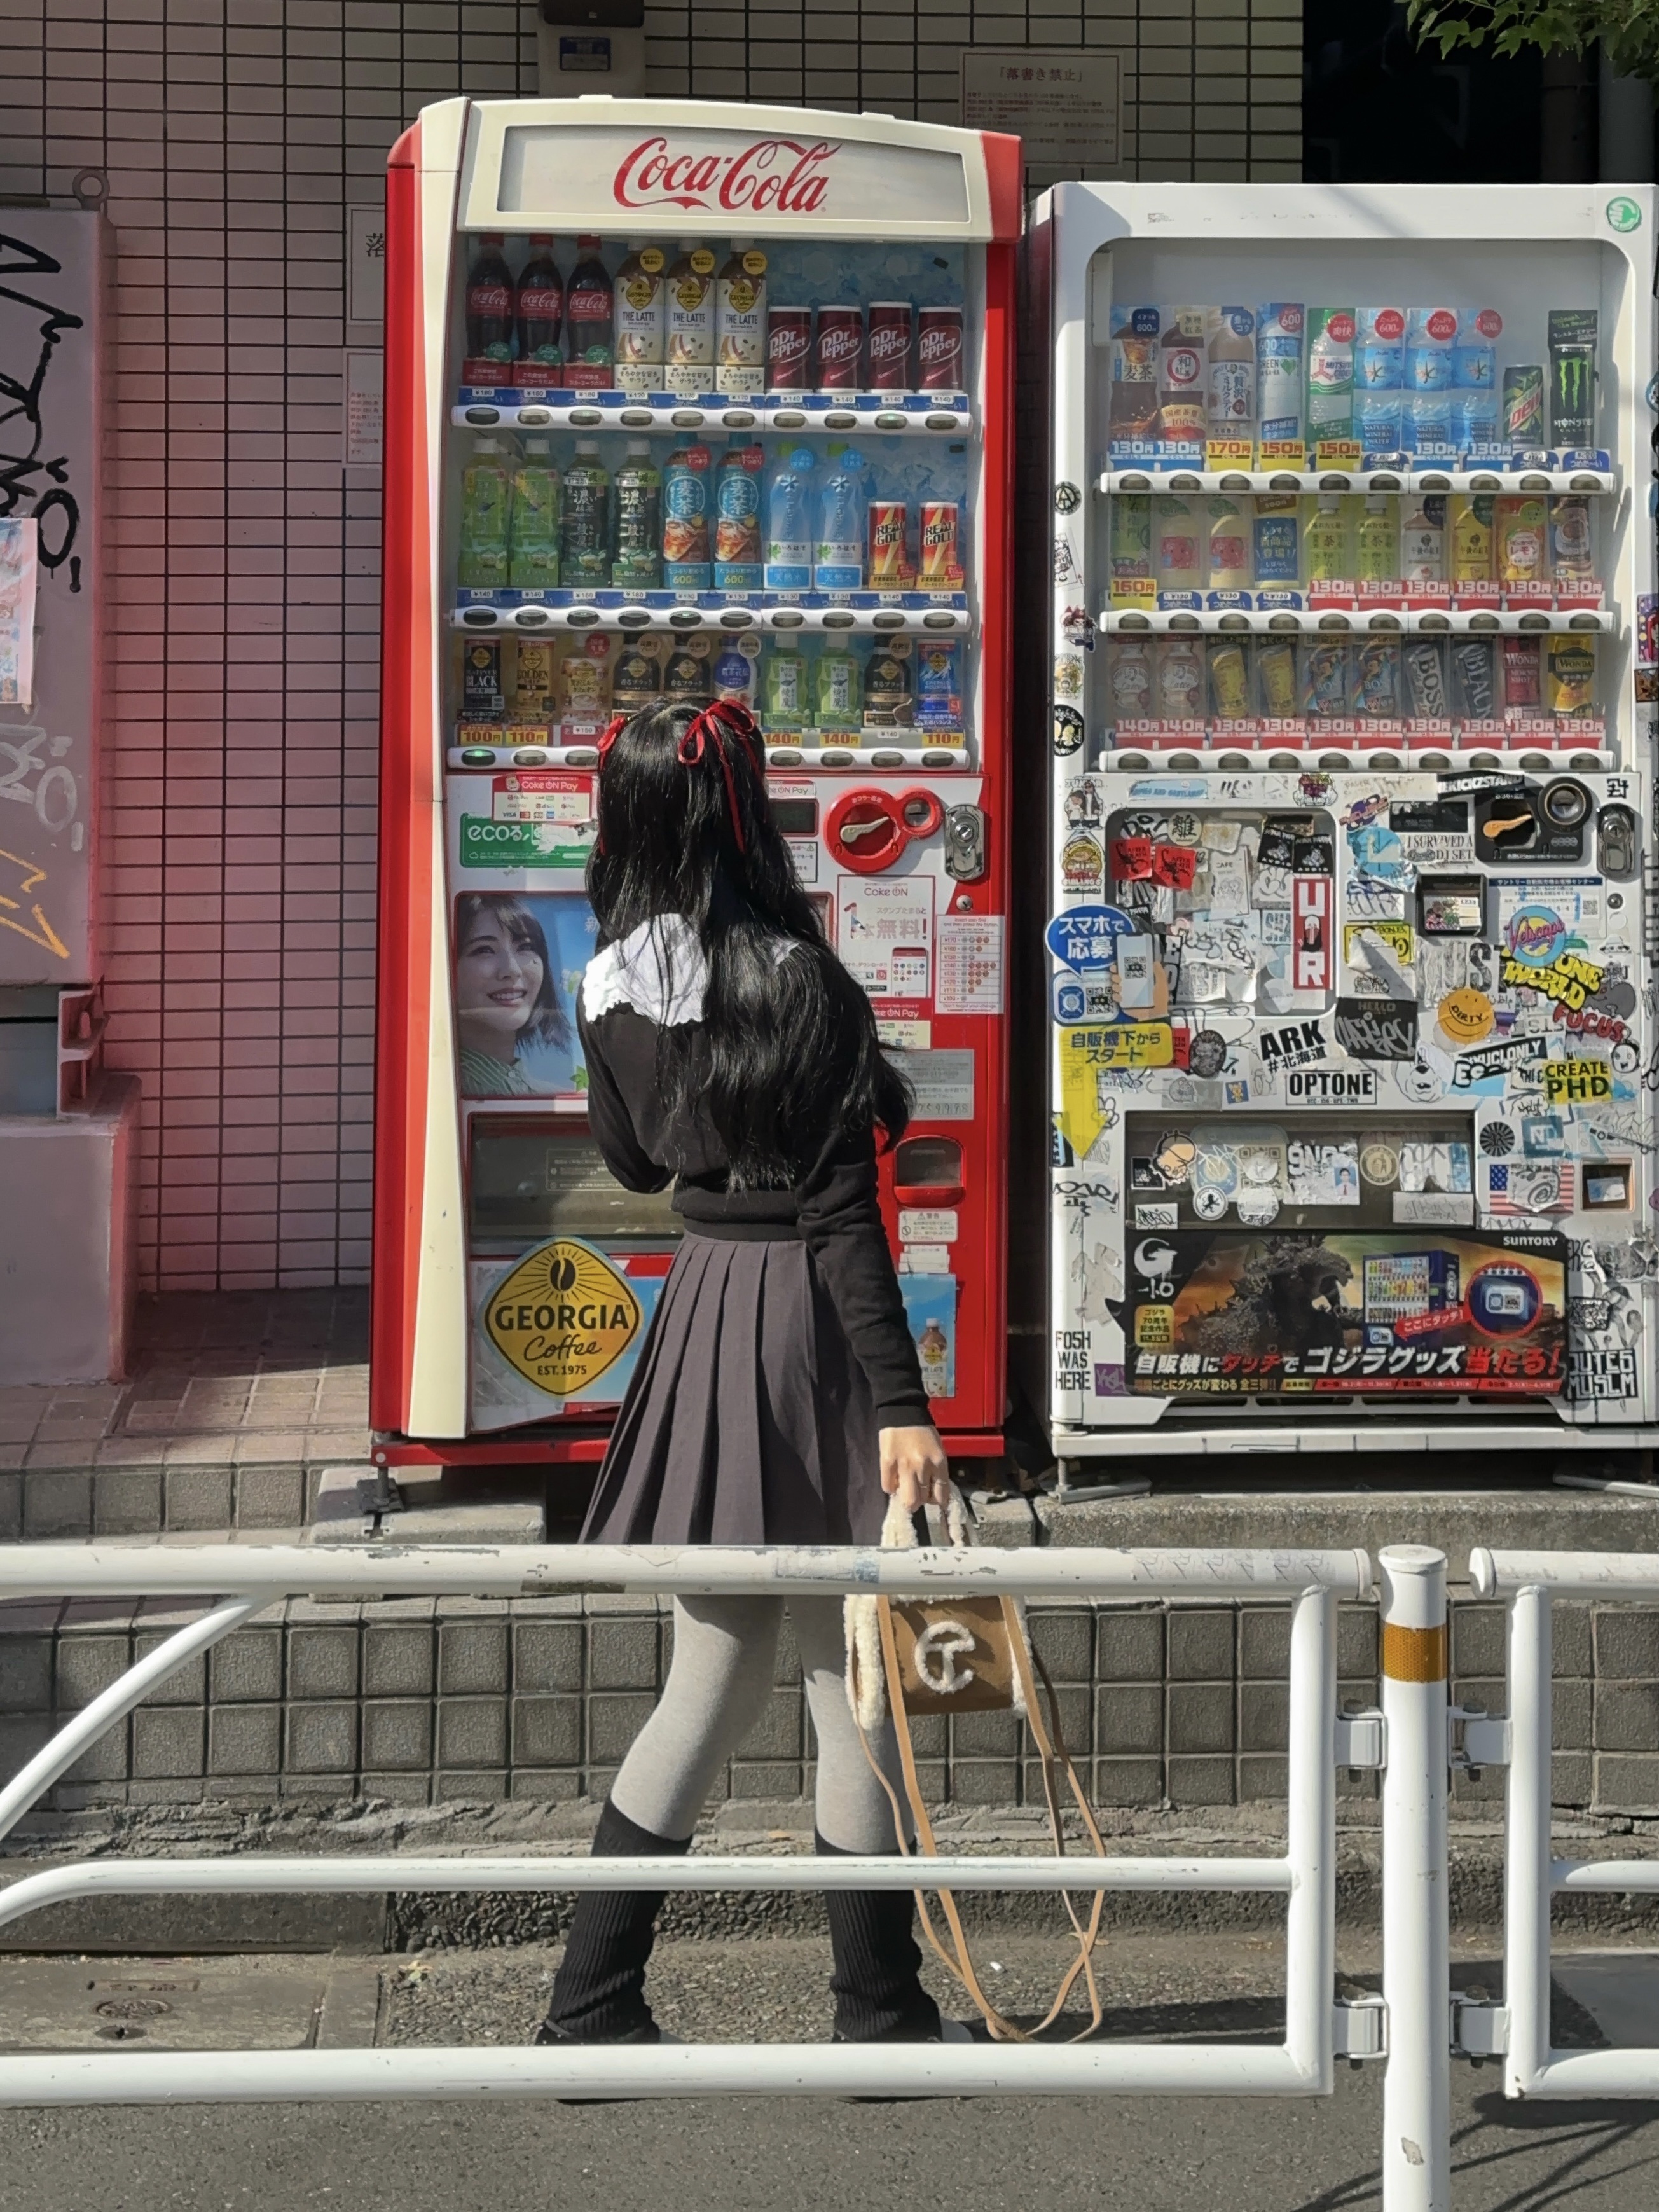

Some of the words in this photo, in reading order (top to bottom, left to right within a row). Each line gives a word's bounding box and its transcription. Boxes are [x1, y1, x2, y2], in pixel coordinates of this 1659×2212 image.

[614, 137, 844, 212] Coca-Cola
[623, 312, 634, 321] THE
[637, 312, 654, 321] LATTE
[673, 313, 685, 322] THE
[687, 313, 705, 322] LATTE
[726, 314, 737, 323] THE
[740, 315, 757, 324] LATTE
[780, 331, 796, 343] Dr
[833, 330, 850, 343] Dr
[881, 329, 898, 343] Dr
[930, 332, 946, 345] Dr
[770, 337, 807, 358] Pepper
[822, 336, 858, 358] Pepper
[871, 335, 907, 358] Pepper
[920, 337, 956, 360] Pepper
[1123, 364, 1152, 381] 麦茶
[1112, 442, 1153, 454] 130円
[1158, 442, 1200, 454] 130円
[1209, 442, 1251, 454] 170円
[1261, 442, 1304, 454] 150円
[1319, 442, 1360, 454] 150円
[1416, 443, 1457, 454] 130円
[1471, 443, 1512, 454] 130円
[678, 481, 694, 515] 麦茶
[731, 481, 747, 515] 麦茶
[877, 523, 905, 536] REAL
[926, 523, 953, 536] REAL
[878, 531, 904, 546] GOLD
[926, 532, 953, 546] GOLD
[1113, 581, 1154, 592] 160円
[1312, 581, 1354, 593] 130円
[1361, 581, 1403, 593] 130円
[1408, 581, 1449, 593] 130円
[1457, 581, 1499, 593] 130円
[1509, 581, 1552, 593] 130円
[1560, 581, 1602, 593] 130円
[466, 675, 497, 687] BLACK
[1419, 656, 1444, 717] BOSS
[1118, 719, 1160, 731] 140円
[1162, 719, 1204, 731] 140円
[1215, 719, 1256, 731] 130円
[1262, 719, 1304, 731] 130円
[1313, 719, 1354, 731] 130円
[1360, 719, 1402, 731] 130円
[1408, 719, 1450, 731] 130円
[1464, 719, 1505, 731] 130円
[1513, 719, 1555, 731] 130円
[1562, 719, 1604, 731] 130円
[464, 732, 501, 742] 100円
[509, 732, 544, 742] 110円
[764, 734, 799, 743] 140円
[823, 734, 858, 743] 140円
[927, 734, 959, 743] 110円
[522, 781, 544, 789] Coke
[561, 782, 579, 791] Pay
[1172, 815, 1197, 838] 離
[1414, 836, 1463, 848] SURVIVED
[1466, 835, 1473, 847] A
[1436, 850, 1449, 861] DJ
[864, 887, 890, 896] Coke
[892, 886, 908, 896] ON
[877, 906, 926, 915] スタンプたまると
[1059, 915, 1125, 936] スマホで
[1067, 936, 1113, 960] 応募
[1358, 1002, 1396, 1013] HELLO
[902, 1011, 919, 1019] Pay
[1452, 1005, 1483, 1023] DIRTY
[1553, 1004, 1627, 1042] FOCUS
[1071, 1030, 1160, 1048] 自販機下から
[1260, 1019, 1327, 1061] ARK
[1085, 1047, 1143, 1064] スタート
[1267, 1046, 1327, 1074] #北海道
[1545, 1061, 1609, 1078] CREATE
[1289, 1073, 1372, 1096] OPTONE
[1548, 1077, 1609, 1100] PHD
[1503, 1236, 1558, 1246] SUNTORY
[495, 1305, 629, 1331] GEORGIA
[1055, 1331, 1091, 1350] FOSH
[524, 1334, 602, 1362] Coffee
[1057, 1352, 1087, 1369] WAS
[538, 1365, 558, 1375] EST.
[561, 1365, 587, 1375] 1975
[1056, 1371, 1091, 1390] HERE
